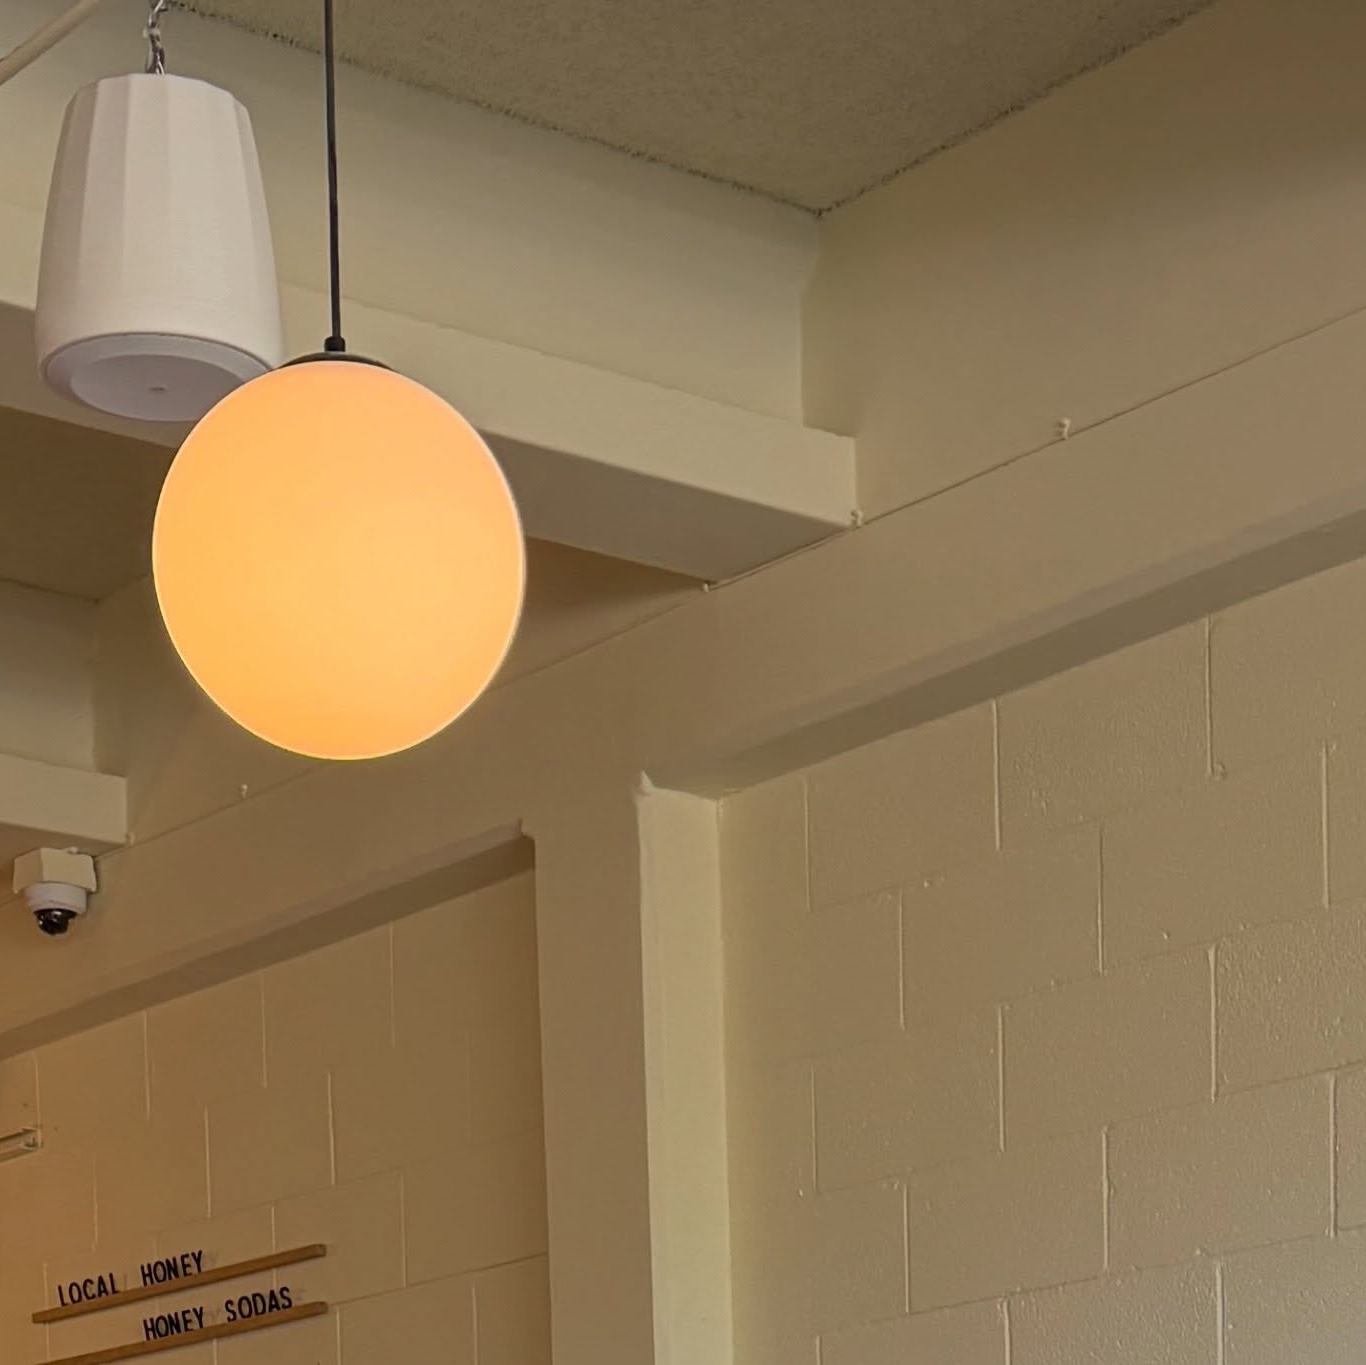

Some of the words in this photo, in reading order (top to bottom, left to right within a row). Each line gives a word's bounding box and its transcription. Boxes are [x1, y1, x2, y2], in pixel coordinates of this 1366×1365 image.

[57, 1272, 120, 1307] LOCAL
[140, 1250, 203, 1287] HONEY
[143, 1306, 204, 1341] HONEY
[224, 1287, 293, 1323] SODAS
